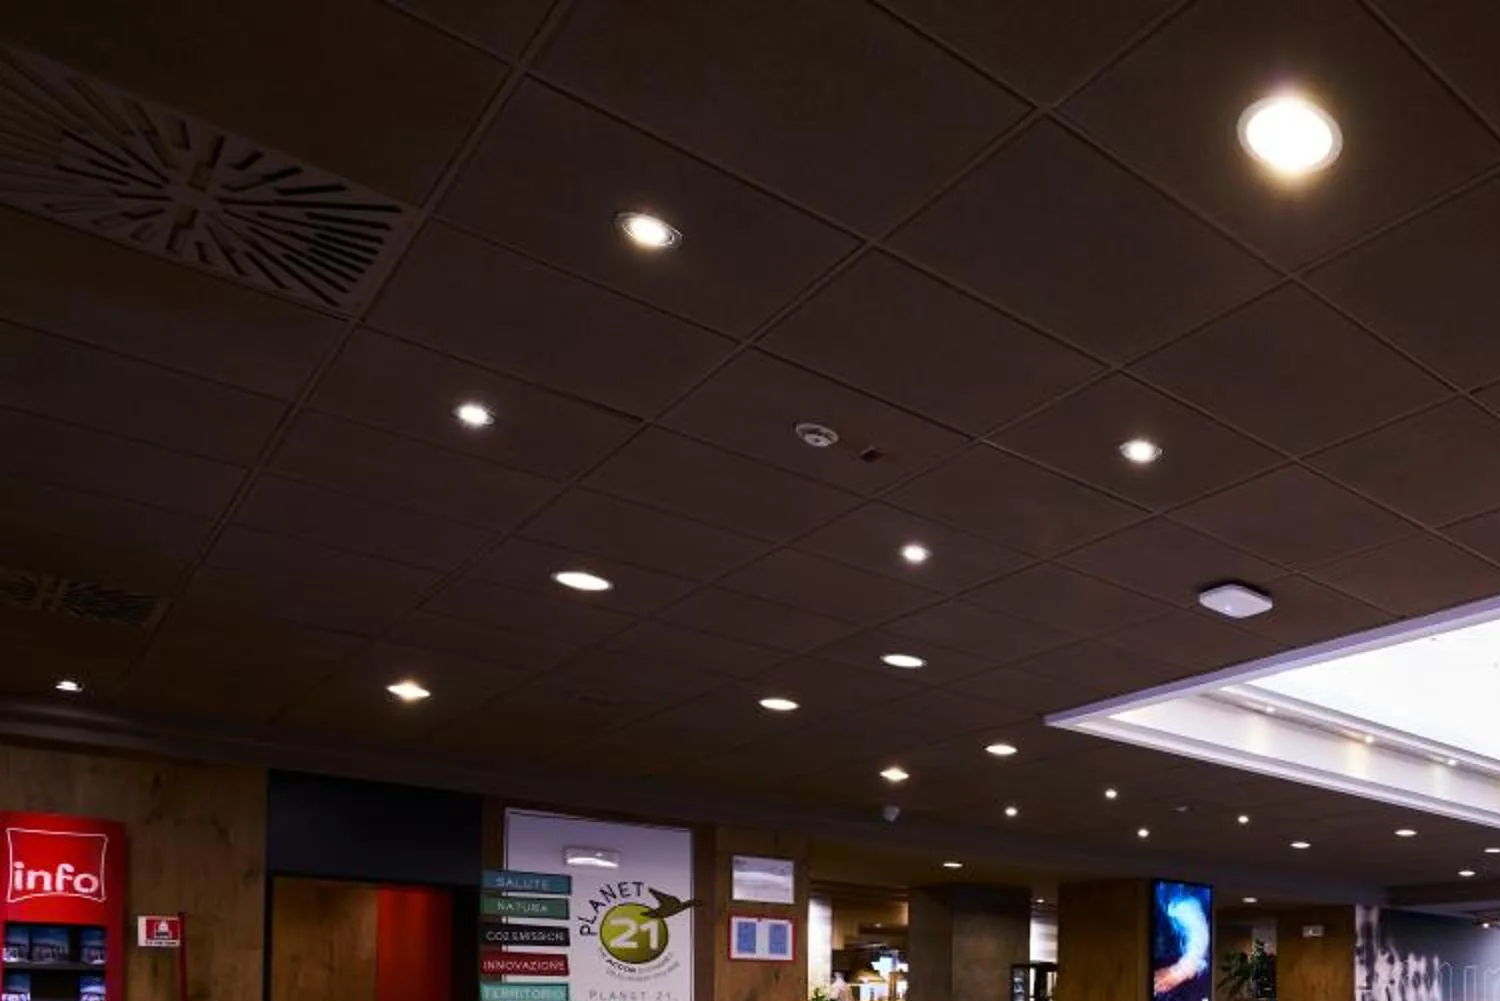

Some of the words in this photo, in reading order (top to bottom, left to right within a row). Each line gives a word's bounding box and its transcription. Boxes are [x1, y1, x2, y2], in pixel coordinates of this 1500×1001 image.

[13, 861, 99, 893] info
[578, 881, 645, 936] PLANET
[610, 916, 659, 949] 21
[483, 960, 565, 971] INNOVAZIONE
